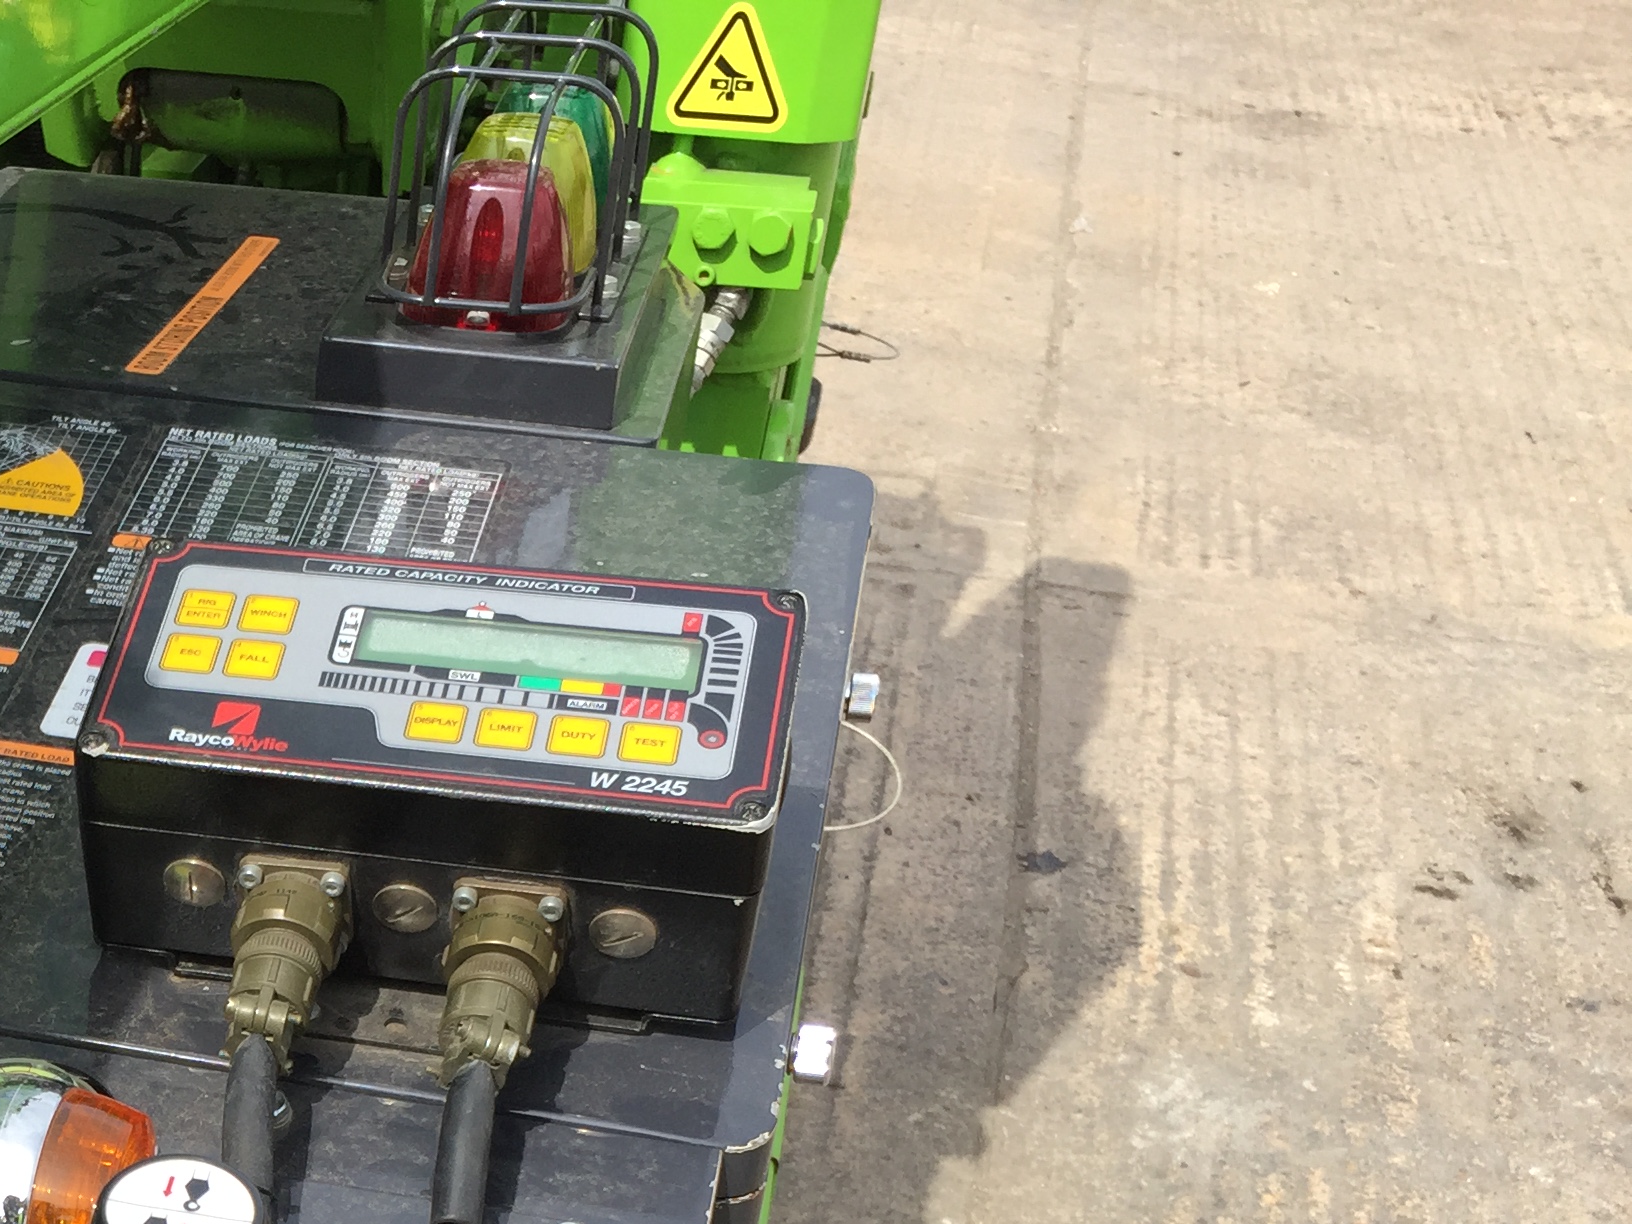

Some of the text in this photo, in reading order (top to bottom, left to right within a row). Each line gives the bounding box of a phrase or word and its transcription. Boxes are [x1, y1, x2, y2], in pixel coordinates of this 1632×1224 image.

[169, 428, 277, 446] NET RATED LOADS
[16, 479, 71, 491] CAUTIONS
[329, 563, 600, 594] RATED CAPACITY INDICATOR
[186, 610, 221, 619] ENTER
[250, 609, 287, 619] WINCH
[180, 648, 201, 656] ESC
[239, 654, 270, 664] FALL
[450, 671, 478, 680] SWL
[569, 700, 606, 711] ALARM
[414, 716, 458, 728] DISPLAY
[488, 724, 524, 734] LIMIT
[561, 730, 596, 742] DUTY
[634, 737, 667, 748] TEST
[7, 749, 39, 759] RATED
[41, 753, 70, 763] LOAD
[590, 772, 689, 796] W 2245
